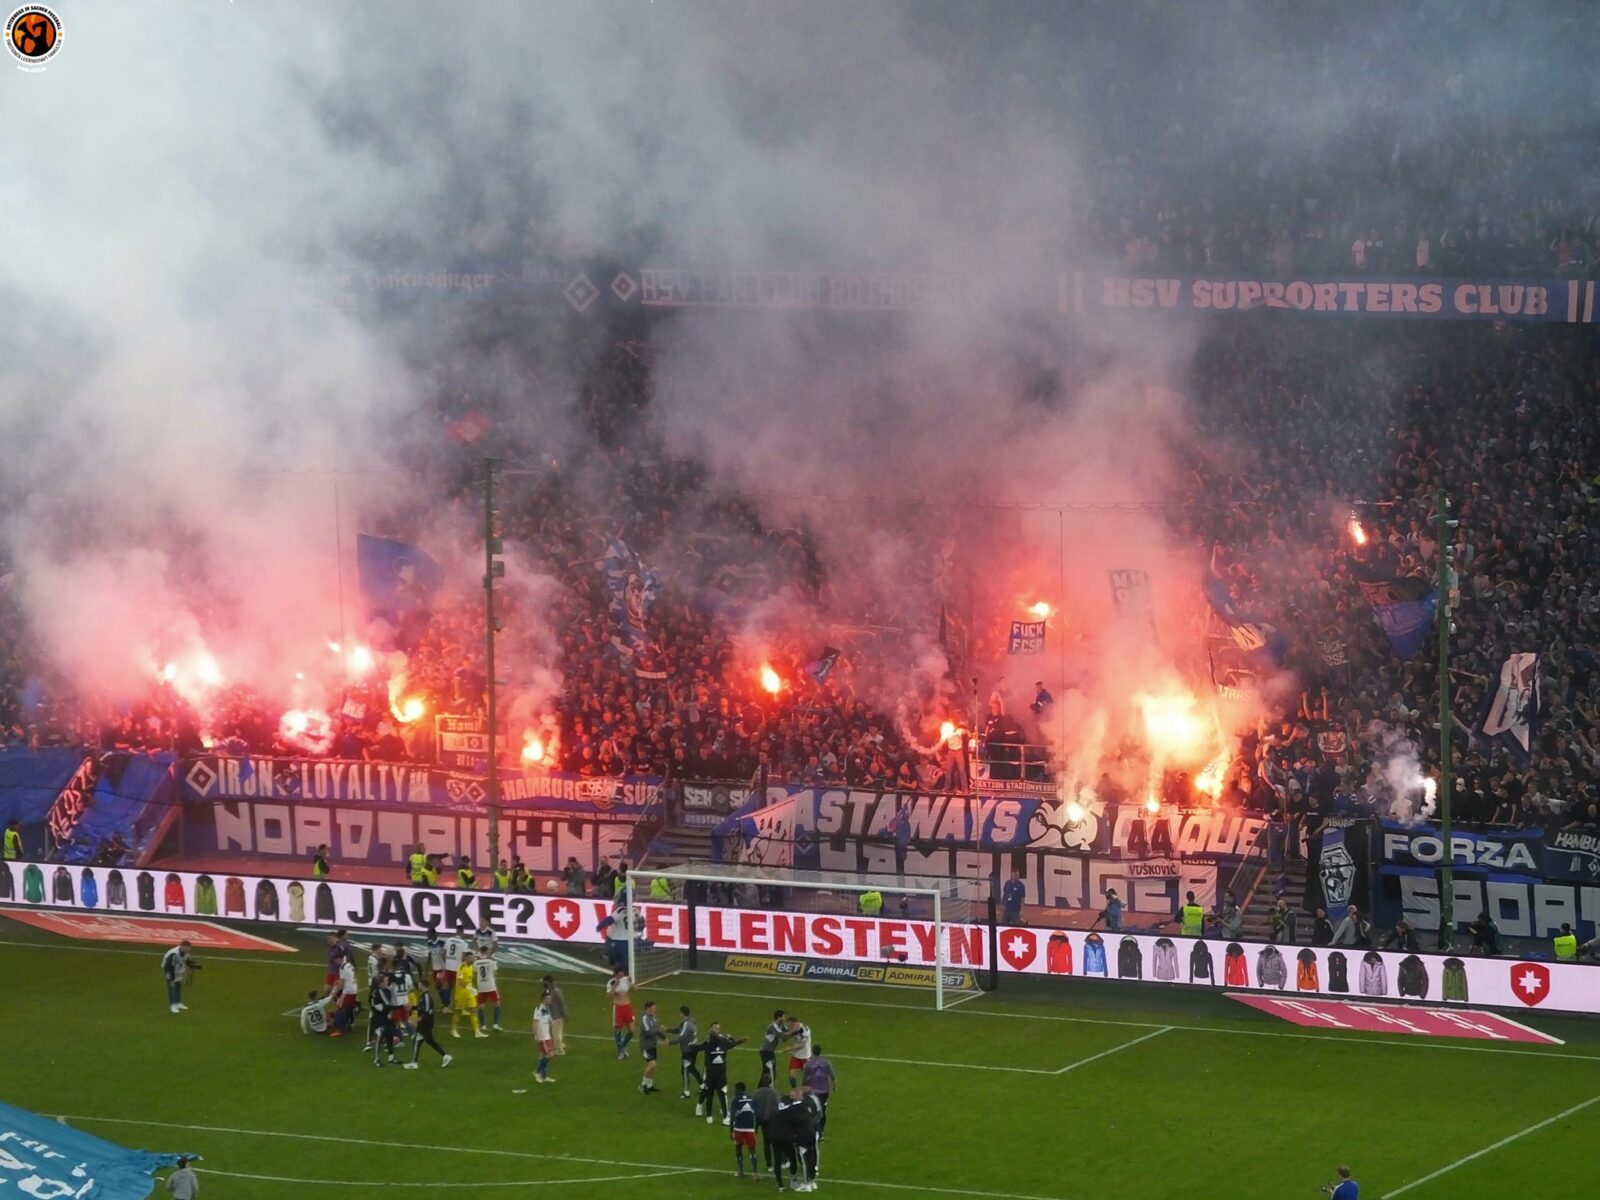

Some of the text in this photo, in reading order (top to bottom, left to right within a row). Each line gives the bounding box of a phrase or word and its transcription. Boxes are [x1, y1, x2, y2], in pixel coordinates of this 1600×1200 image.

[1102, 279, 1548, 315] HSV SUPPORTERS CLUB
[1013, 623, 1044, 637] FUCK
[301, 763, 405, 801] LOYALTY
[1384, 833, 1537, 869] FORZA
[1554, 832, 1600, 853] HAMBU
[1129, 864, 1178, 876] VUŠKOVIĆ
[347, 888, 535, 934] JACKE?
[308, 1009, 323, 1023] 28
